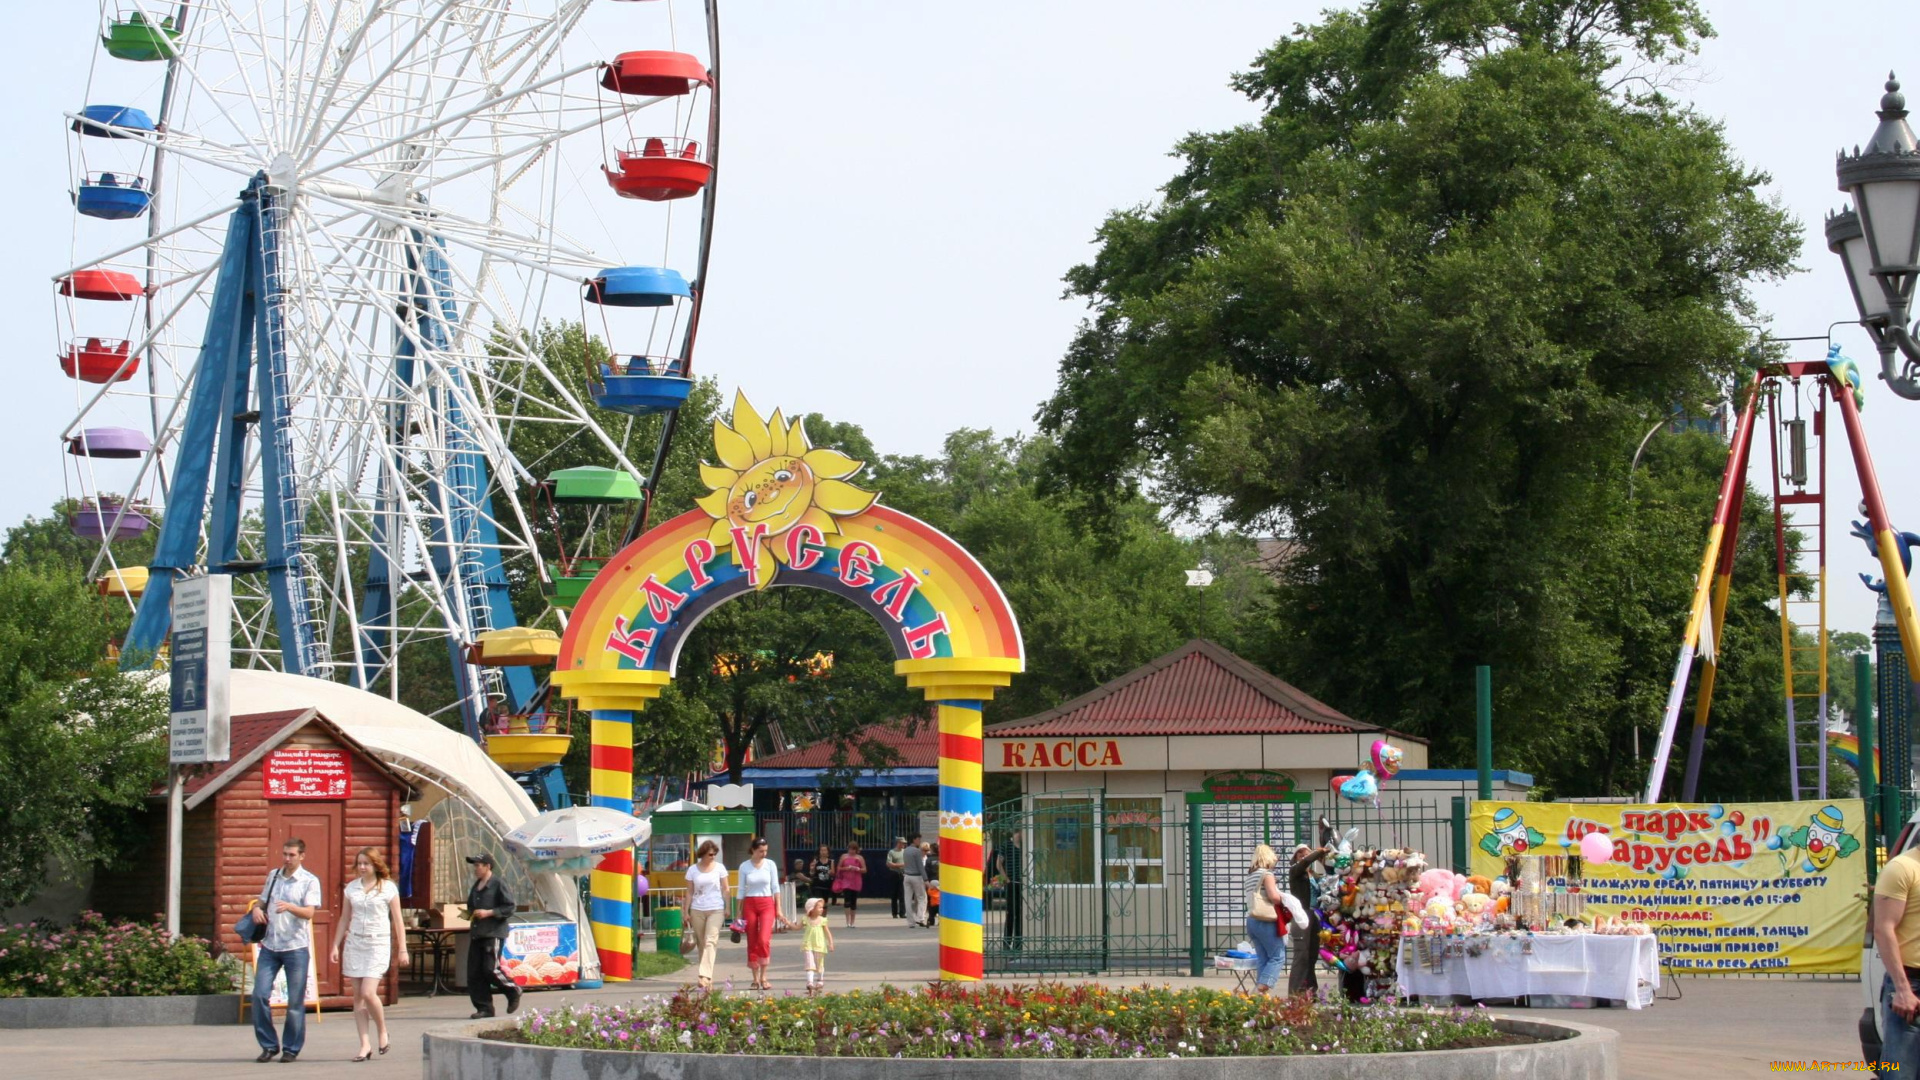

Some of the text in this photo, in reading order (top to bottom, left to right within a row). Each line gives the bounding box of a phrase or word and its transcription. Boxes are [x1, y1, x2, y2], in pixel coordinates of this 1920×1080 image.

[605, 523, 951, 668] КАРУСЕЛЬ
[1002, 740, 1123, 768] КАССА
[1623, 812, 1712, 841] парк
[1591, 879, 1650, 890] КАЖДУЮ
[1653, 879, 1696, 891] СРЕДУ,
[1700, 879, 1758, 891] ПЯТНИЦУ
[1761, 879, 1769, 889] И
[1773, 877, 1828, 888] СУББОТУ
[1611, 895, 1692, 906] ПРАЗДНИКИ!
[1706, 895, 1740, 905] 12:00
[1743, 895, 1764, 906] ДО
[1767, 893, 1801, 904] 15:00
[1631, 911, 1713, 921] ПРОГРАММЕ:
[1715, 926, 1760, 937] ПЕСНИ,
[1762, 926, 1809, 937] ТАНЦЫ
[1725, 942, 1779, 953] ПРИЗОВ!
[1696, 958, 1714, 968] НА
[1717, 958, 1747, 968] ВЕСЬ
[1750, 957, 1790, 969] ДЕНЬ!
